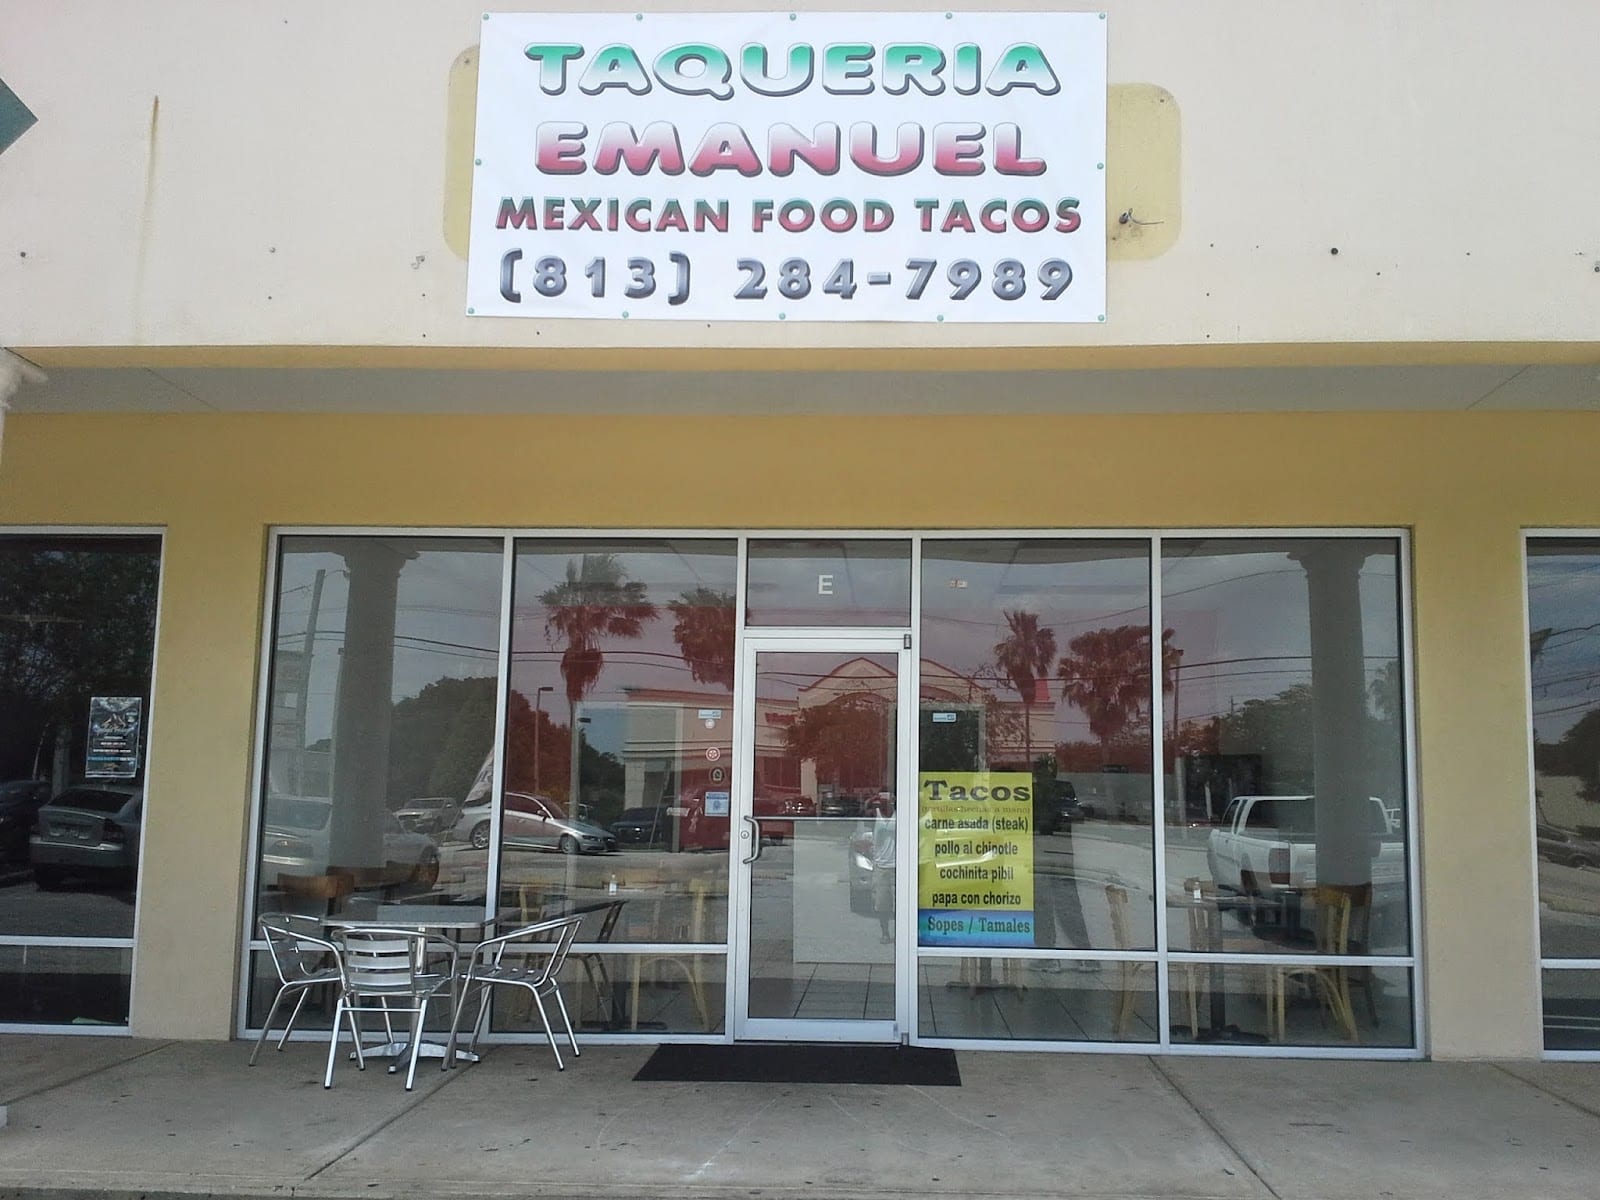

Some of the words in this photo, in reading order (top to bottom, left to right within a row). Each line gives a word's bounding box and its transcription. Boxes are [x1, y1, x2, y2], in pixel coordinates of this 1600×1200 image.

[524, 41, 1062, 100] TAQUERIA
[534, 120, 1047, 178] EMANUEL
[496, 195, 730, 234] MEXICAN
[751, 197, 895, 234] FOOD
[914, 196, 1082, 234] TACOS
[499, 247, 691, 305] (813)
[733, 256, 1074, 301] 284-7989
[818, 574, 834, 595] E
[923, 779, 1031, 802] Tacos
[924, 818, 955, 830] carne
[958, 816, 989, 830] asada
[992, 816, 1028, 833] (steak)
[935, 841, 960, 856] pollo
[963, 841, 973, 855] al
[975, 841, 1018, 856] chipotle
[940, 866, 989, 879] cochinita
[991, 866, 1014, 882] pibil
[932, 893, 959, 907] papa
[961, 893, 980, 905] con
[983, 891, 1021, 905] chorizo
[927, 915, 964, 935] Sopes
[978, 918, 1030, 933] Tamales
